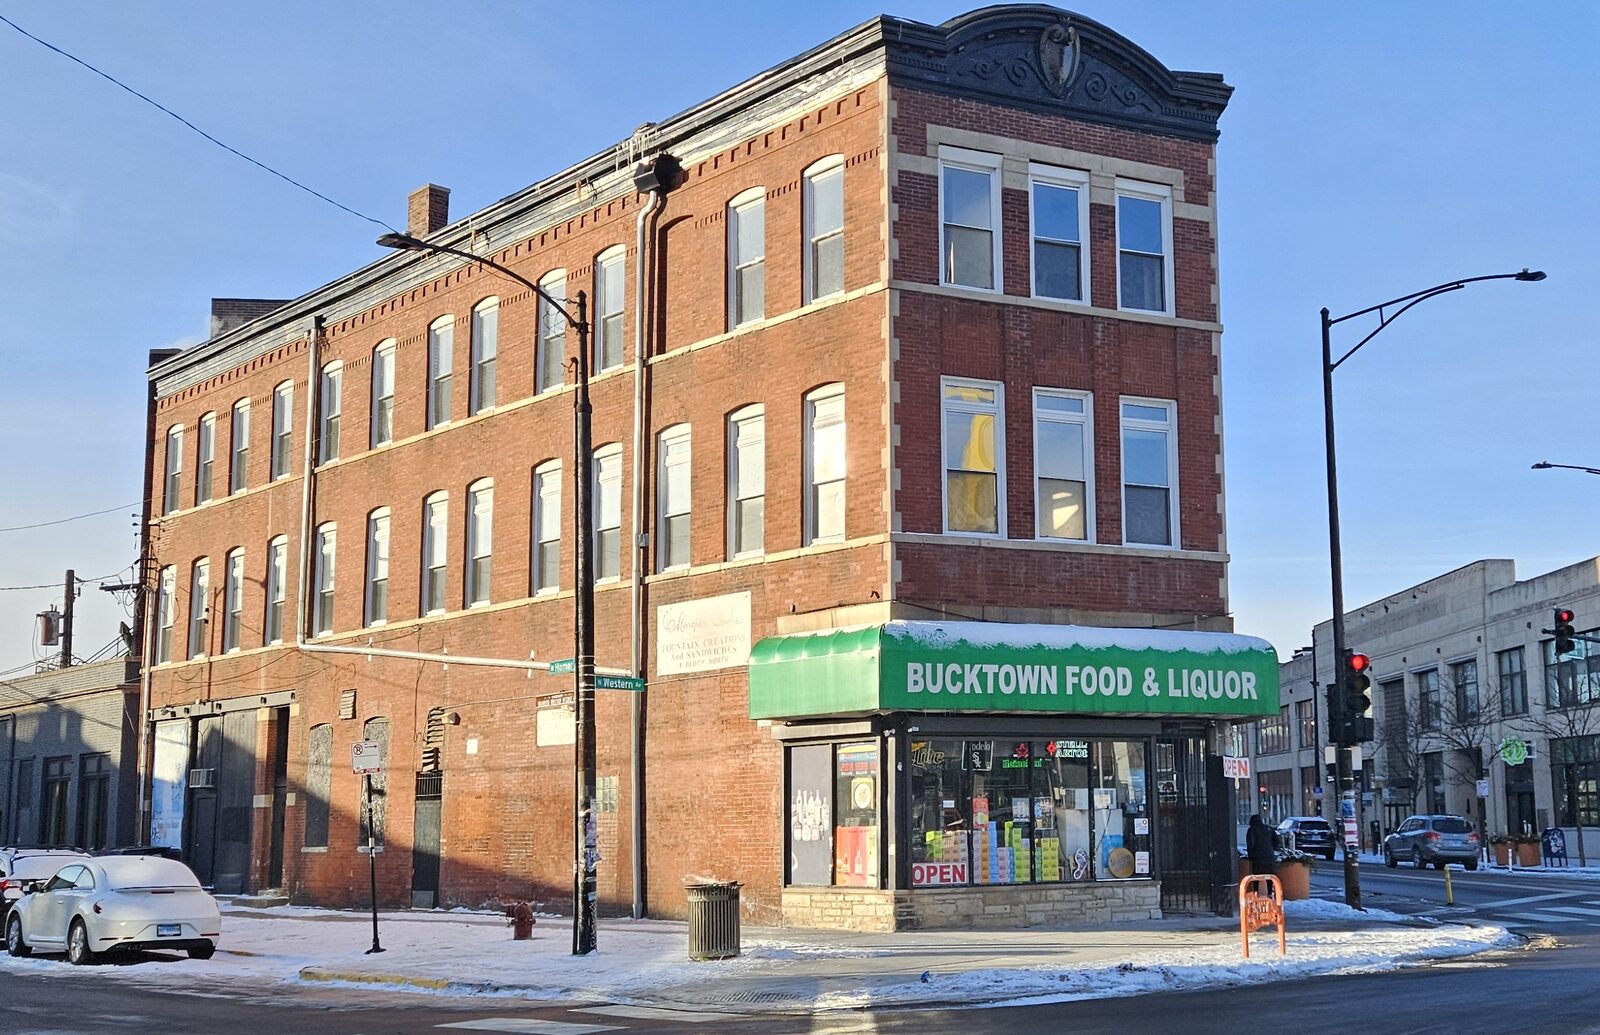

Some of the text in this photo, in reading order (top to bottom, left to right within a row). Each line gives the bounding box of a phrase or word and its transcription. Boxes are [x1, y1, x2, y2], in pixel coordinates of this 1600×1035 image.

[662, 635, 746, 653] FOUNTAIN CREATIONS
[686, 646, 737, 659] SANDWICHES
[603, 678, 634, 689] Western
[907, 662, 1258, 700] BUCKTOWN FOOD & LIQUOR
[969, 740, 991, 751] odelo
[911, 747, 945, 768] Lite
[1224, 759, 1249, 777] OPEN
[912, 863, 966, 884] OPEN
